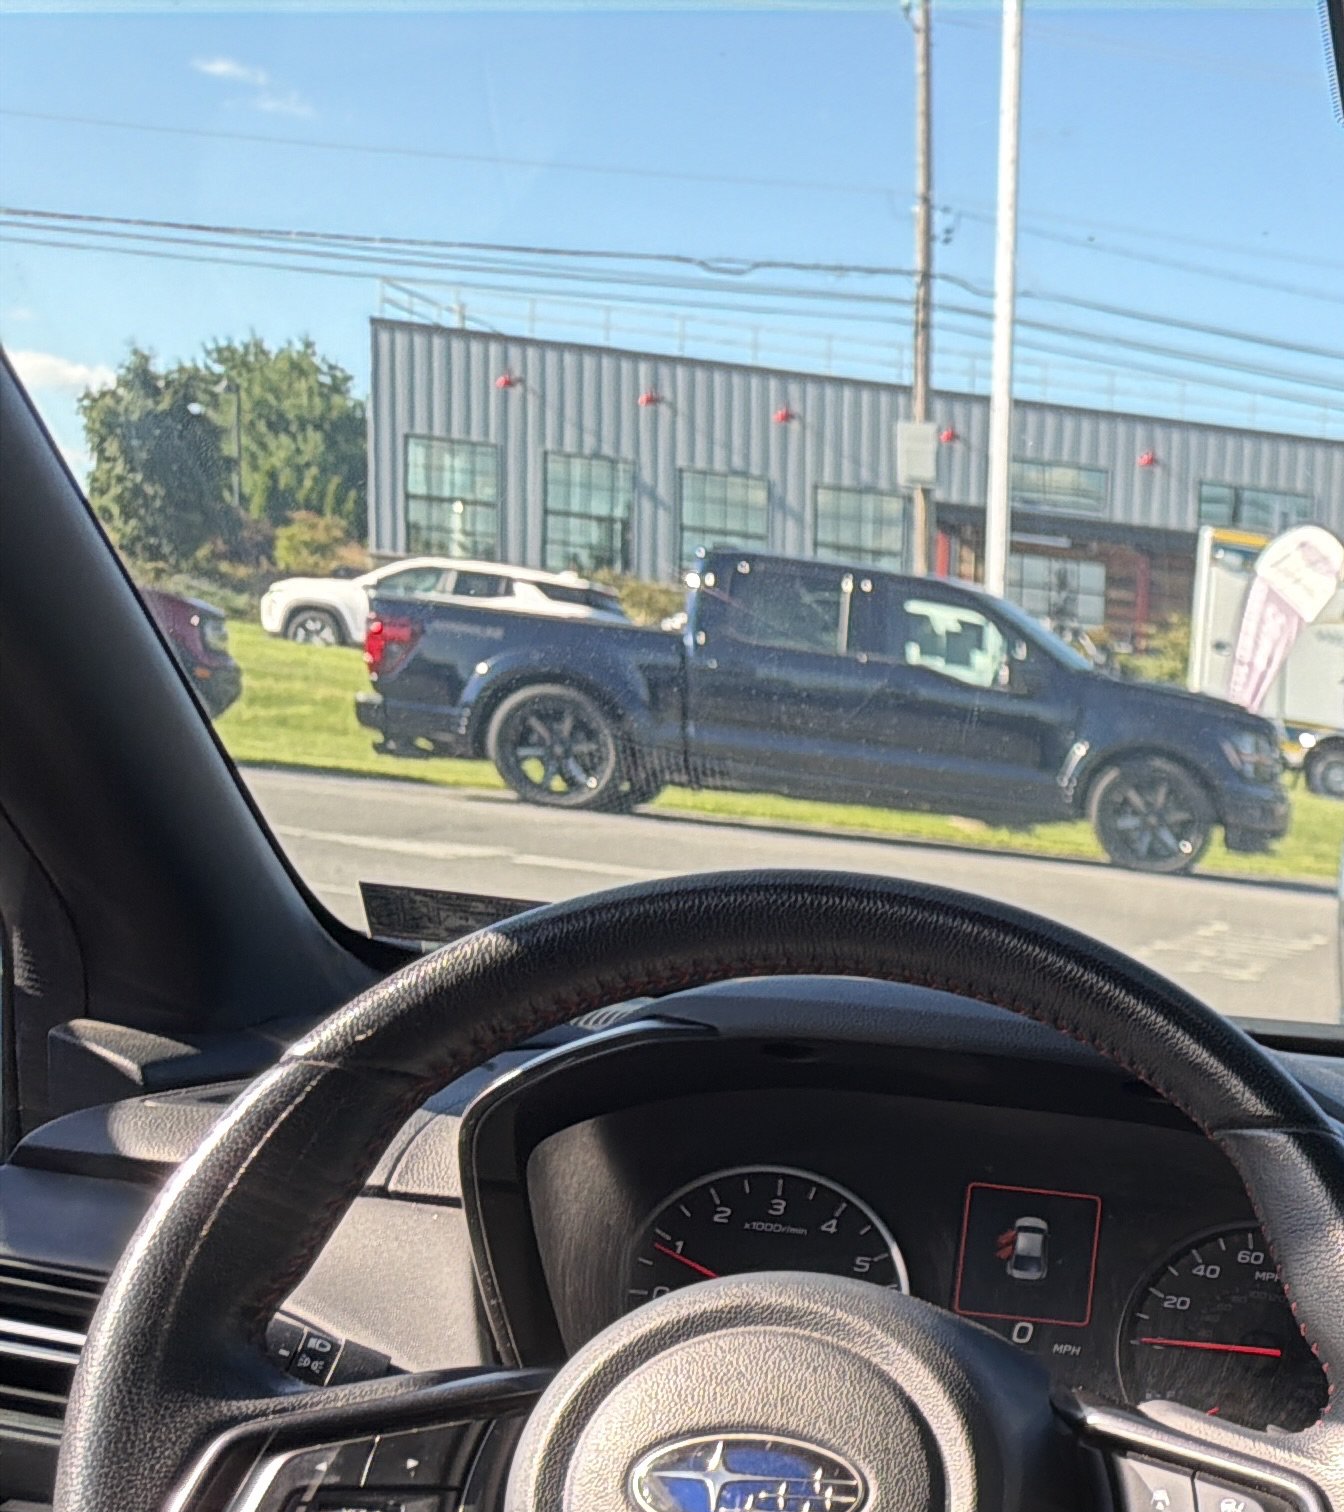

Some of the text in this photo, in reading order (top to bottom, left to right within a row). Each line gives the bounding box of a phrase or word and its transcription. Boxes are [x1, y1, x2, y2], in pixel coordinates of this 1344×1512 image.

[713, 1206, 732, 1223] 2
[768, 1199, 786, 1216] 3
[820, 1218, 838, 1234] 4
[675, 1240, 685, 1254] 1
[853, 1256, 872, 1273] 5
[1237, 1250, 1264, 1265] 60
[1191, 1265, 1220, 1279] 40
[1163, 1296, 1191, 1310] 20
[1012, 1321, 1034, 1344] 0
[1052, 1343, 1081, 1356] MPH
